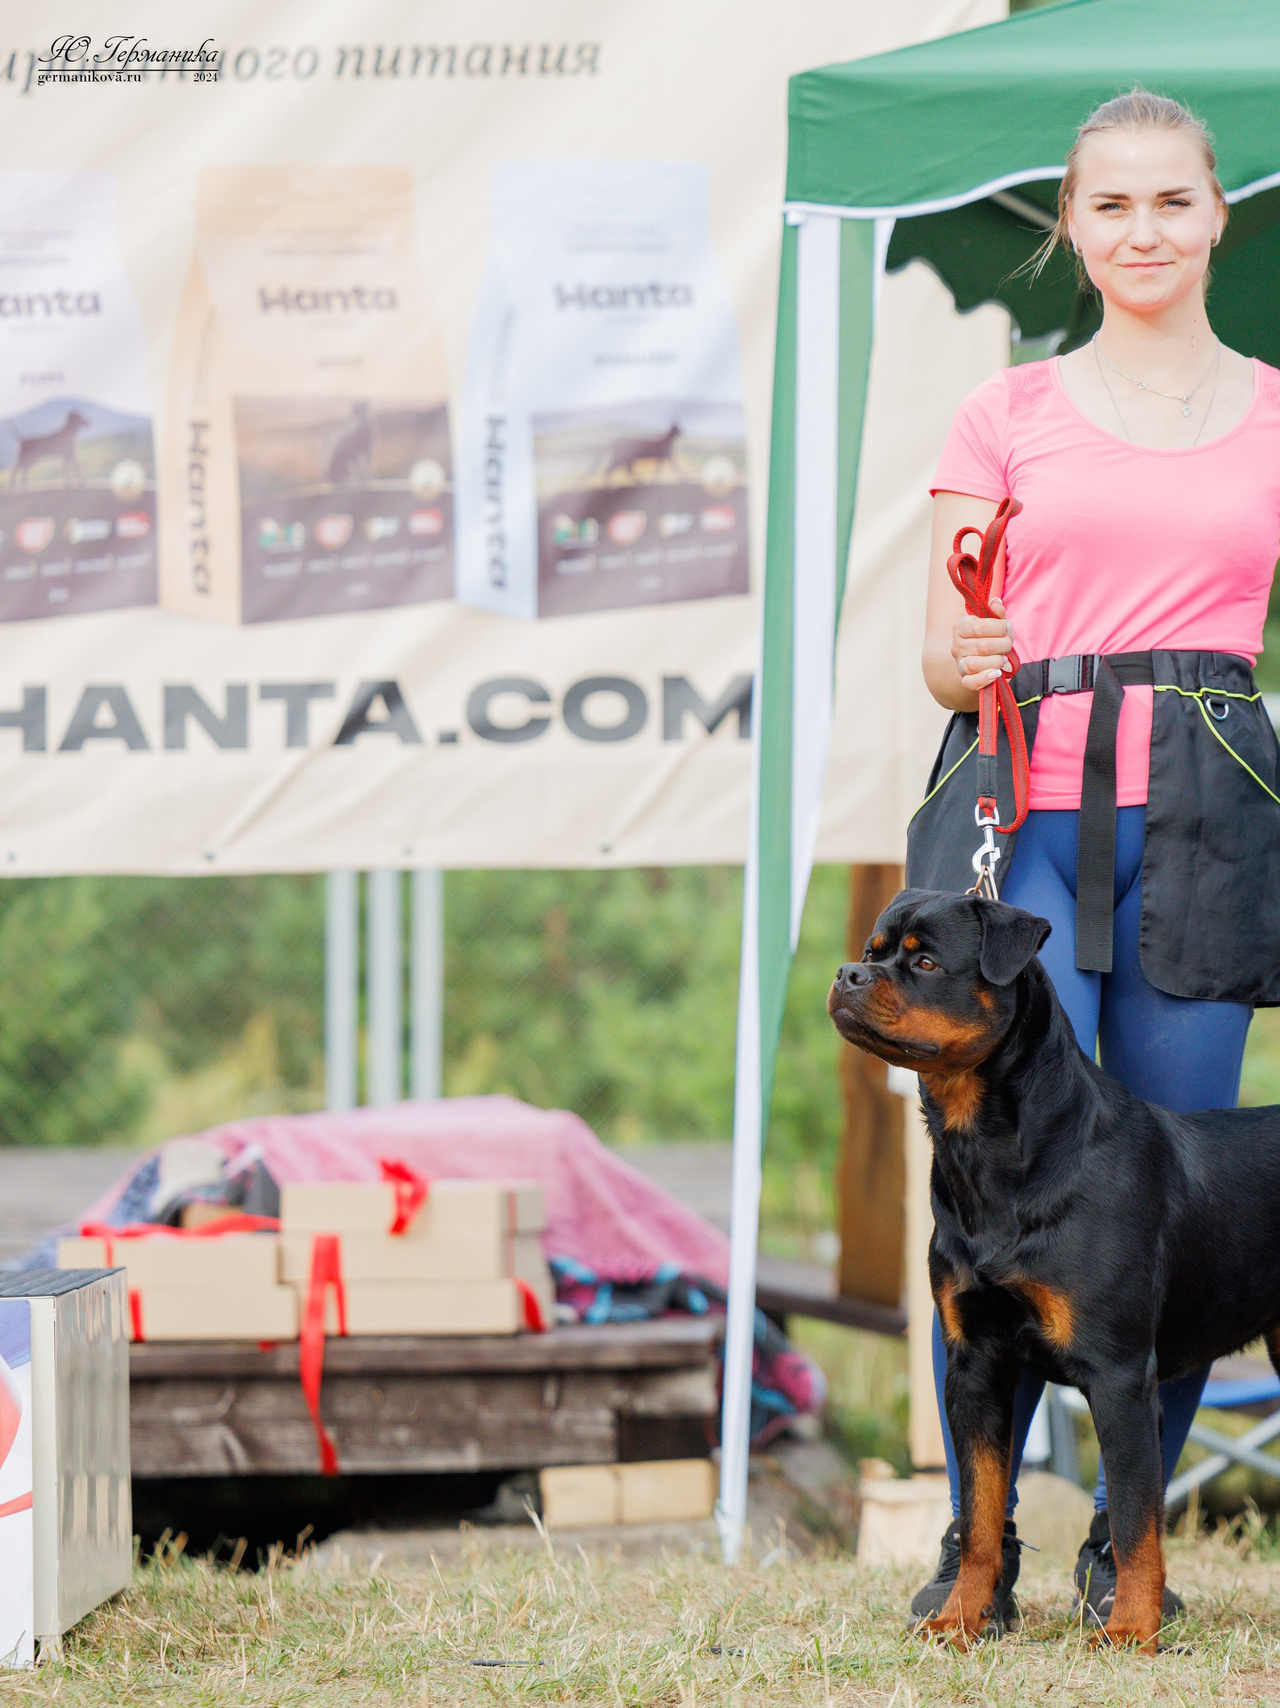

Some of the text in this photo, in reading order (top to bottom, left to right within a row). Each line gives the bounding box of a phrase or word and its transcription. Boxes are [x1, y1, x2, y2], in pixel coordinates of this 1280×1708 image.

[335, 40, 602, 82] питания
[258, 286, 397, 314] Hanta
[554, 282, 692, 311] Hanta
